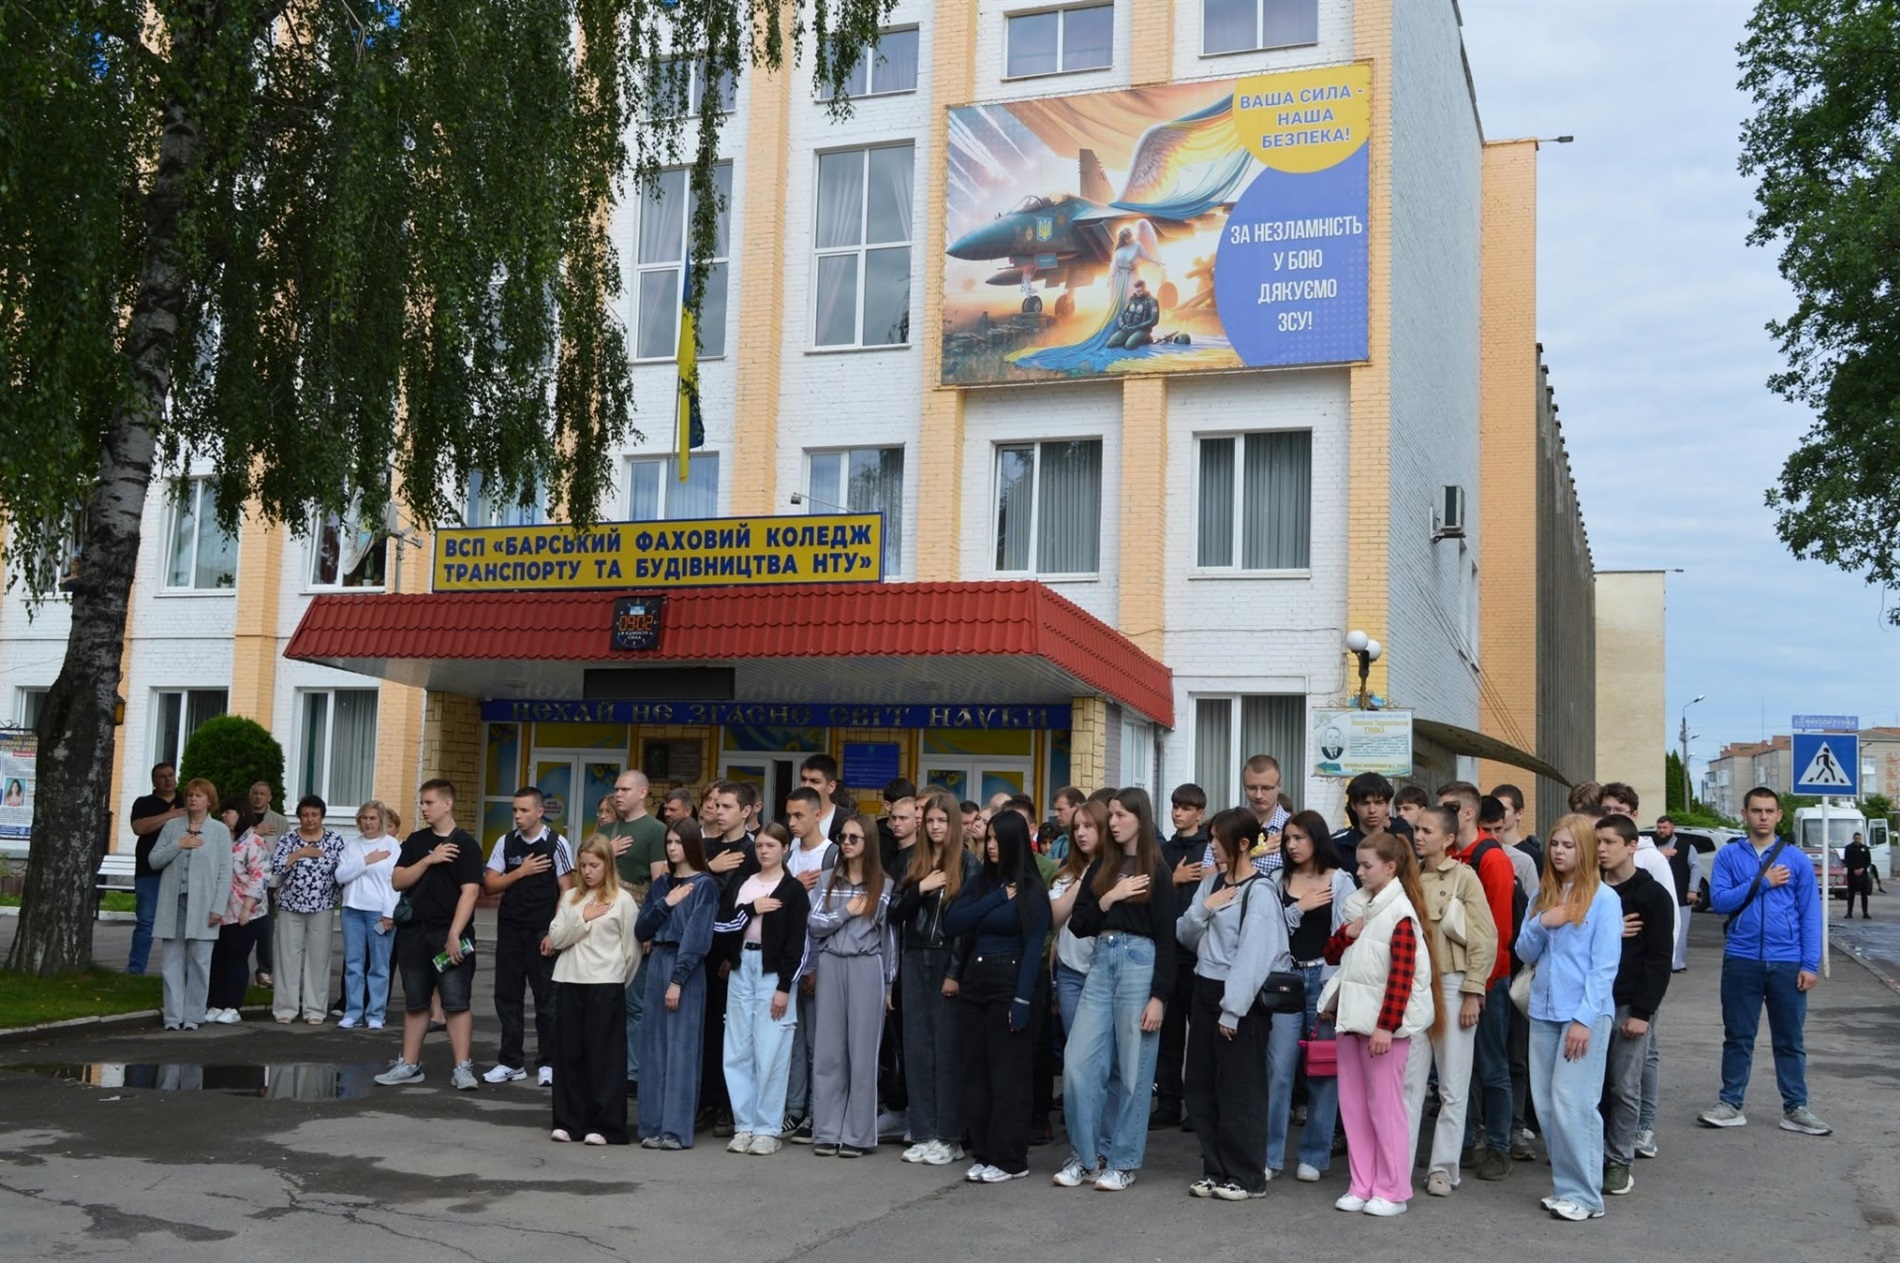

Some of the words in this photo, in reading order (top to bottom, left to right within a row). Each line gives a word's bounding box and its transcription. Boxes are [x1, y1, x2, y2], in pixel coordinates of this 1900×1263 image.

[1239, 89, 1295, 110] ВАША
[1299, 84, 1351, 104] СИЛА
[1277, 107, 1334, 126] НАША
[1262, 127, 1350, 150] БЕЗПЕКА!
[1230, 222, 1250, 245] ЗА
[1254, 215, 1363, 243] НЕЗЛАМНІСТЬ
[1273, 251, 1285, 272] У
[1287, 249, 1323, 271] БОЮ
[1257, 278, 1337, 305] ДЯКУЄМО
[1277, 311, 1313, 333] ЗСУ!
[445, 538, 485, 557] ВСП
[493, 528, 621, 555] «БАРСЬКИЙ
[635, 523, 751, 552] ФАХОВИЙ
[766, 524, 872, 549] КОЛЕДЖ
[444, 560, 581, 582] ТРАНСПОРТУ
[594, 559, 622, 578] ТА
[636, 554, 798, 581] БУДІВНИЦТВА
[813, 553, 872, 573] НТУ»
